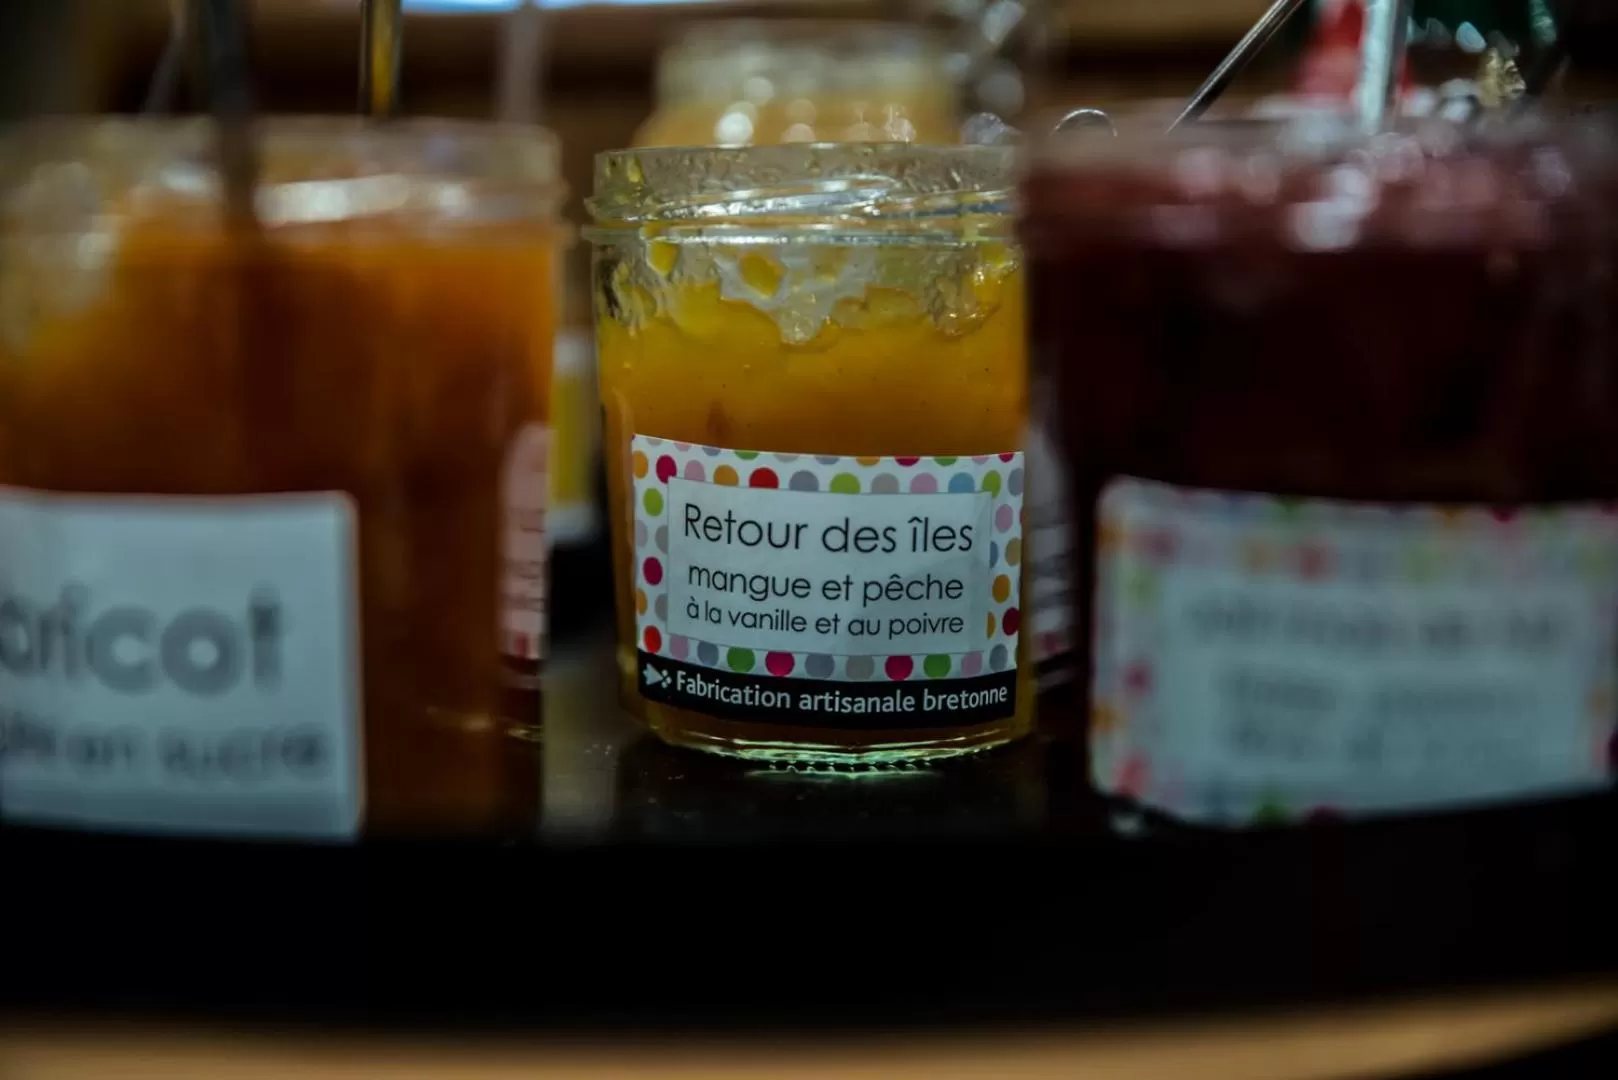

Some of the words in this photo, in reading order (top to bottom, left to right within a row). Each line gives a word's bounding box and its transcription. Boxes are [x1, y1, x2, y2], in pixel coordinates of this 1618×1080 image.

[684, 502, 809, 550] Retour
[822, 516, 897, 554] des
[907, 515, 974, 553] îles
[688, 564, 811, 602] mangue
[822, 574, 854, 601] et
[863, 573, 964, 609] pêche
[686, 596, 700, 620] à
[704, 600, 722, 625] la
[728, 609, 808, 633] vanille
[815, 613, 841, 635] et
[848, 618, 881, 637] au
[889, 612, 965, 640] poivre
[676, 669, 791, 709] Fabrication
[798, 689, 916, 714] artisanale
[923, 686, 1009, 712] bretonne
